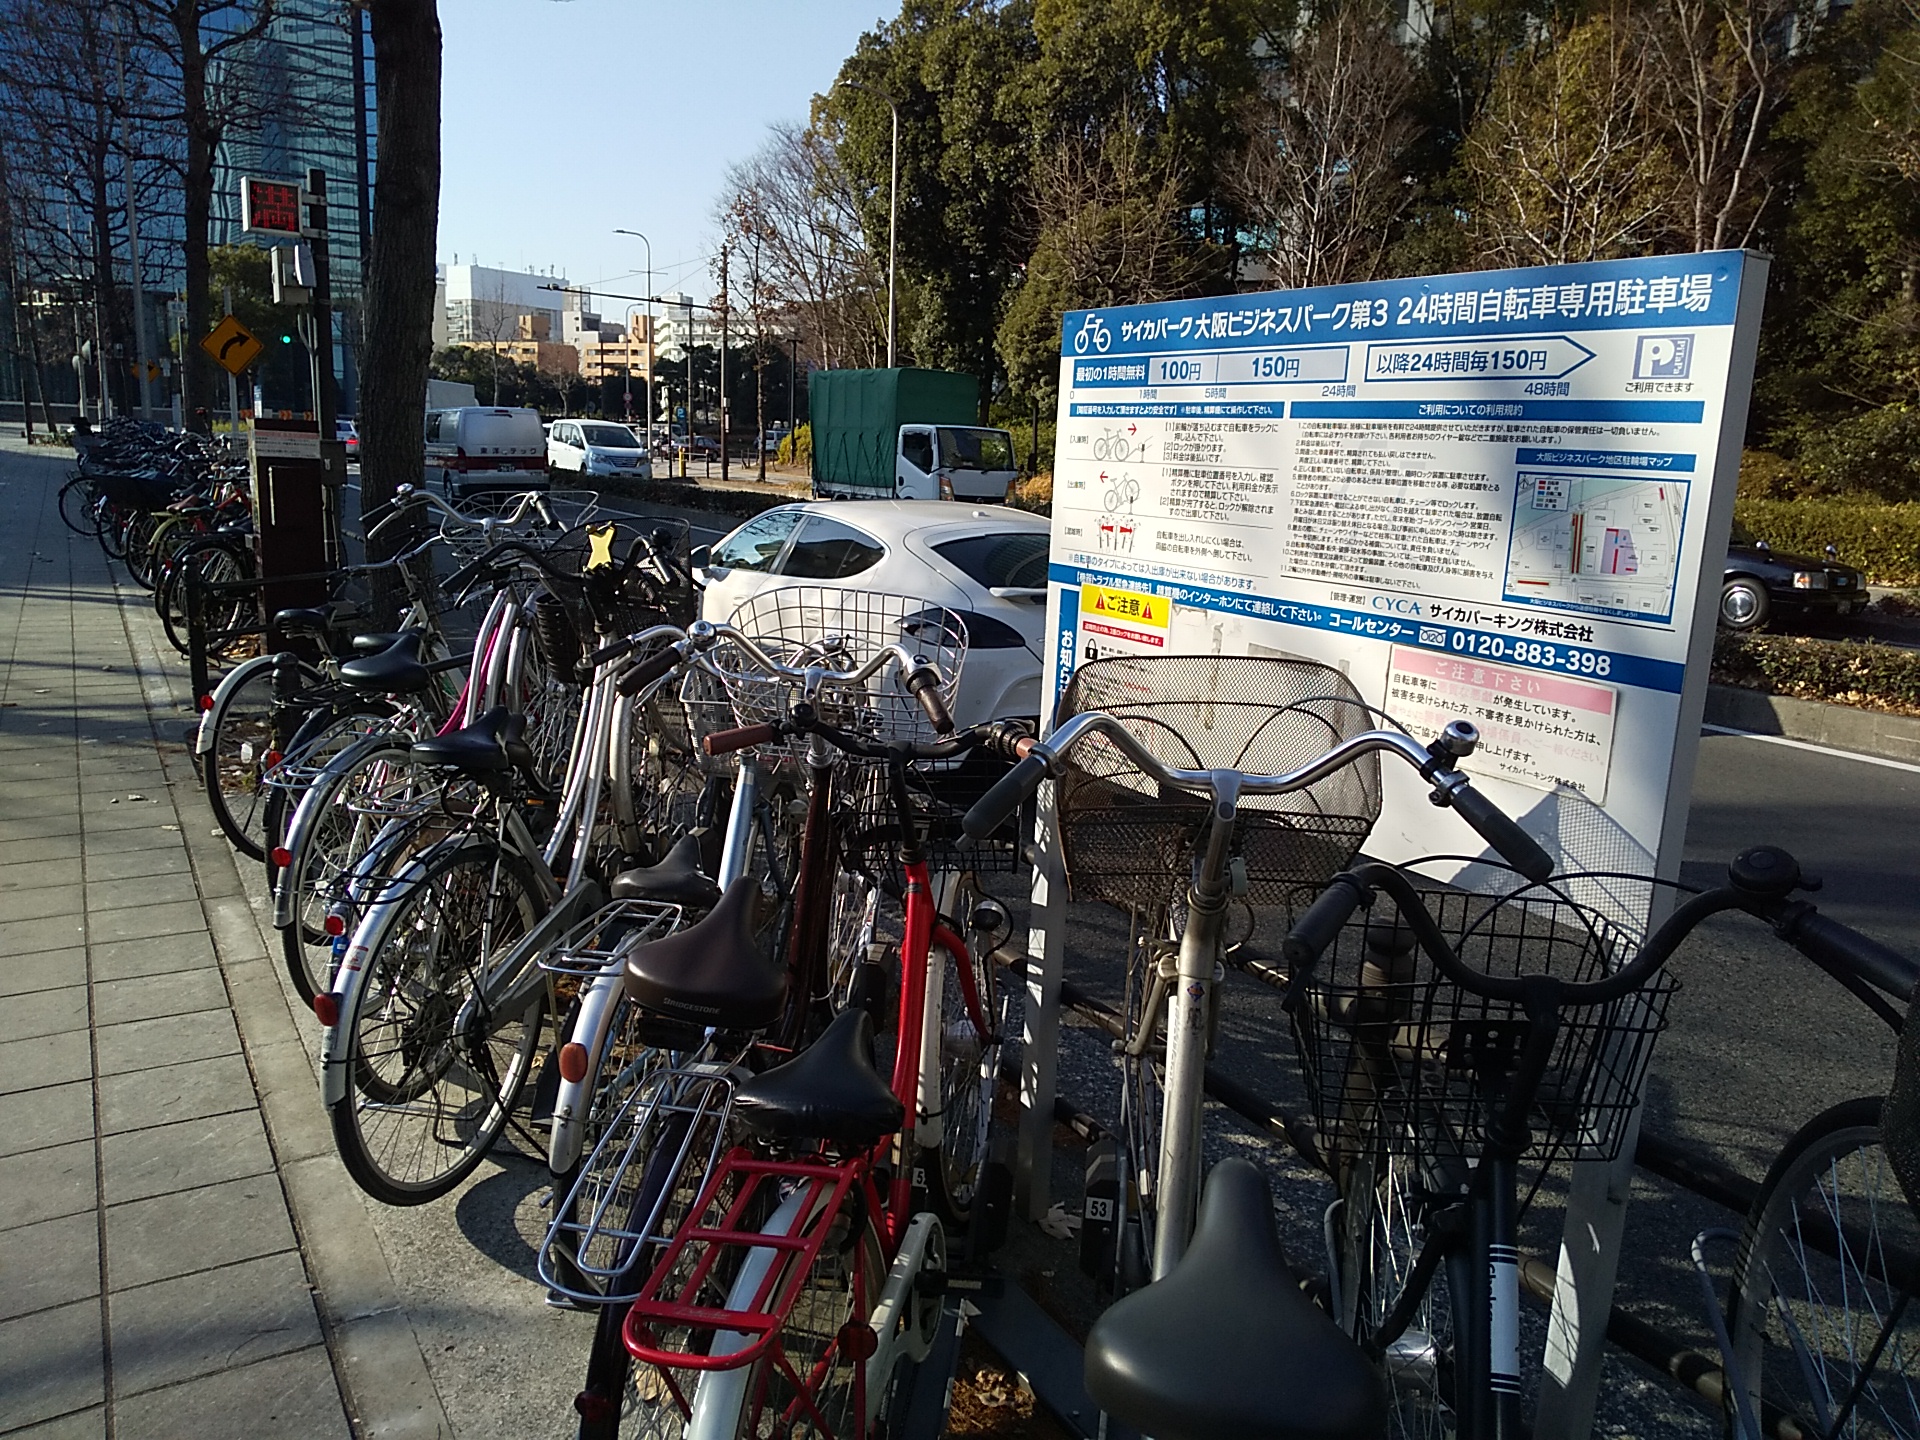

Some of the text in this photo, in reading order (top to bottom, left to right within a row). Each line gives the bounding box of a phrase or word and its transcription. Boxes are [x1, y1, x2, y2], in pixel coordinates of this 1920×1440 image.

[1396, 274, 1713, 326] 24時間自転車専用駐車場
[1160, 360, 1201, 381] 100円
[1251, 356, 1300, 379] 150円
[1375, 349, 1548, 375] 以降24時間毎150円
[1075, 364, 1146, 382] 最初の1時間無料
[1139, 388, 1158, 399] 1時間
[1204, 387, 1227, 399] 5時間
[1321, 384, 1357, 398] 24時間
[1524, 382, 1570, 397] 48時間
[1624, 381, 1694, 393] ご利用できます
[1418, 404, 1524, 417] ご利用についての利用規約
[1535, 452, 1673, 468] 大阪ビジネスパーク地区駐輪場マップ
[1105, 594, 1141, 617] ご注意
[1371, 595, 1422, 616] CYCA
[1429, 603, 1594, 643] サイカパーキング株式会社
[1328, 612, 1415, 637] コールセンター
[1452, 631, 1611, 677] 0120-883-398
[1434, 660, 1541, 693] ご注意下さい
[1498, 762, 1587, 793] サイカパーキング株式会社
[663, 997, 720, 1015] BRIDGESTONE
[1090, 1200, 1107, 1218] 53
